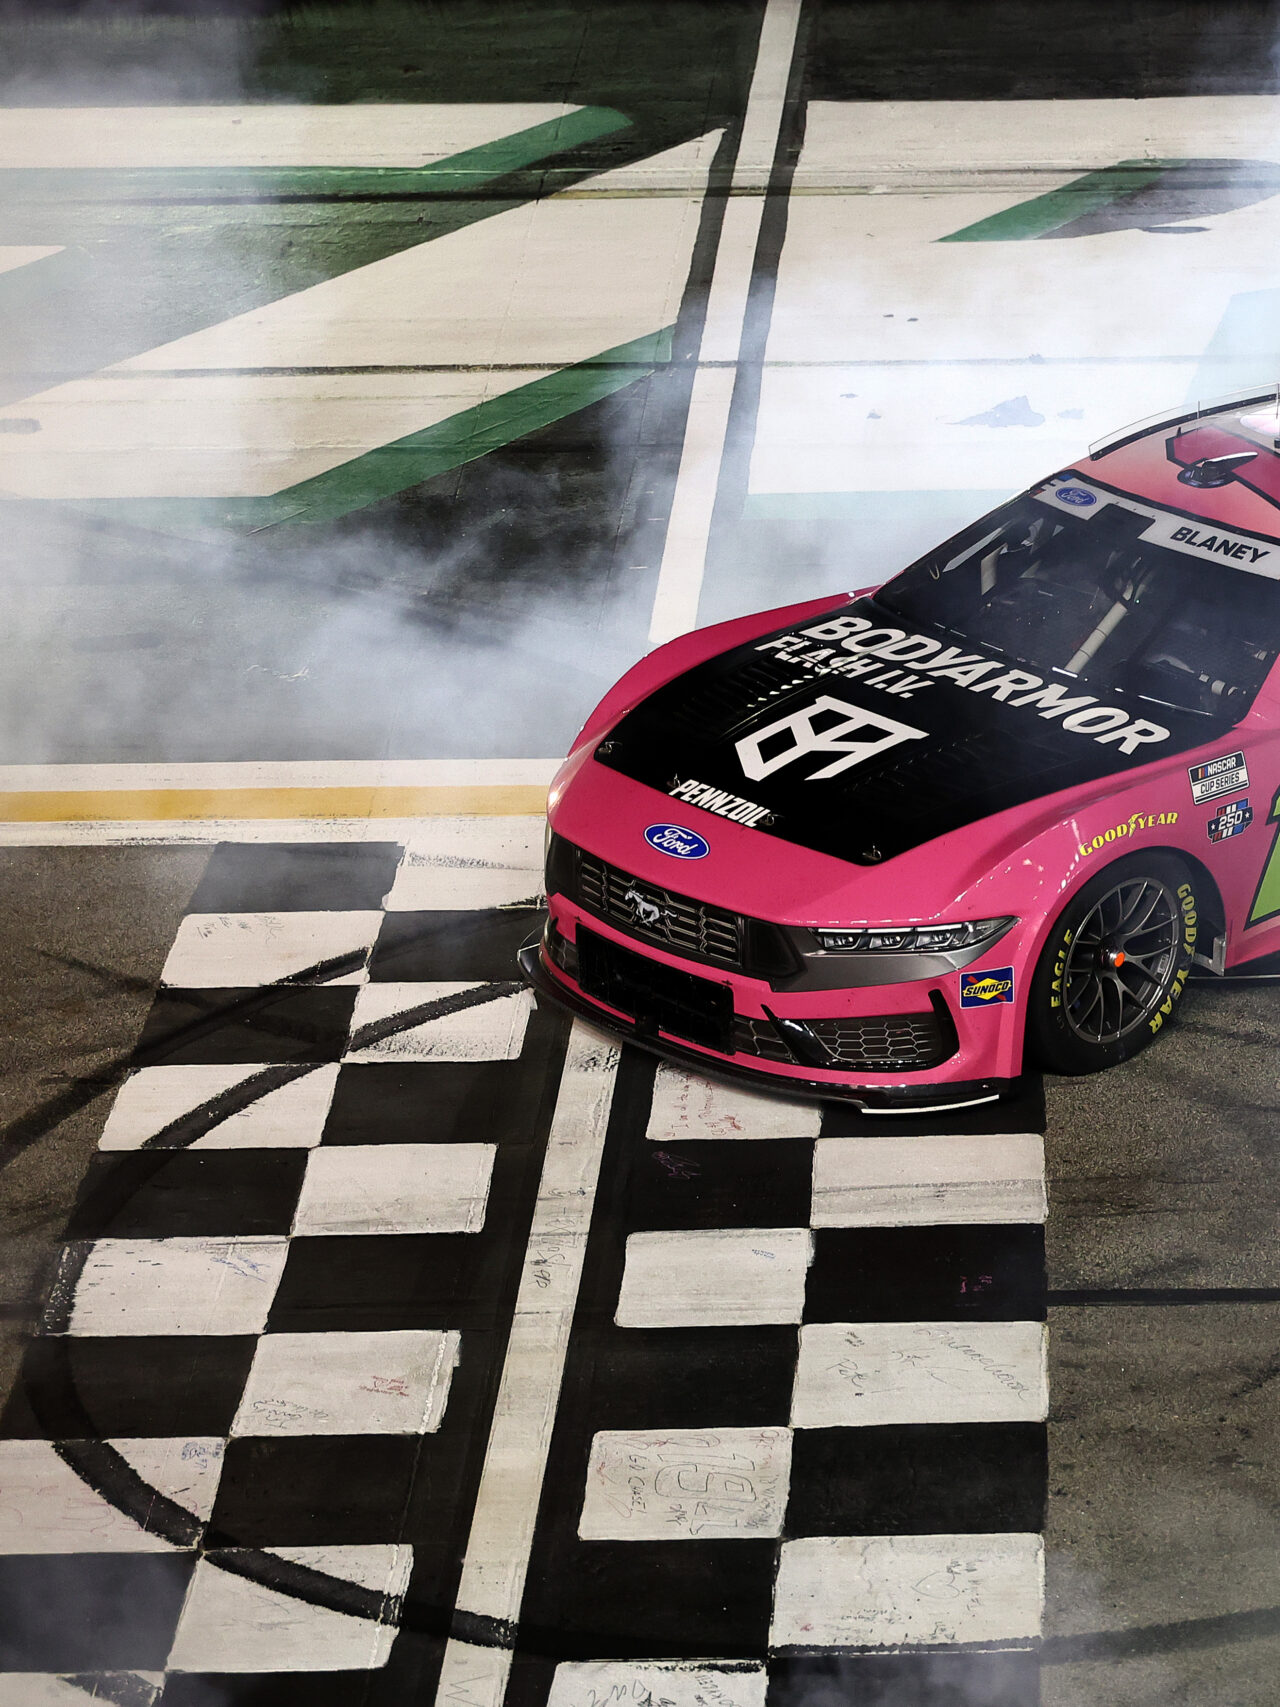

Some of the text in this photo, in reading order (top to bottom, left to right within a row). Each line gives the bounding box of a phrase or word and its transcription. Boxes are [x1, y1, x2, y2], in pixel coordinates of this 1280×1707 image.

[1169, 525, 1270, 564] BLANEY
[799, 616, 1171, 755] BODYARMOR
[863, 669, 936, 699] I.V.
[1207, 757, 1237, 777] NASCAR
[1200, 772, 1241, 794] CUP SERIES
[668, 779, 771, 828] PENNZOIL
[1217, 810, 1243, 831] 250
[651, 827, 699, 856] Ford
[1050, 929, 1074, 1008] EAGLE
[963, 980, 1012, 998] SUNOCO
